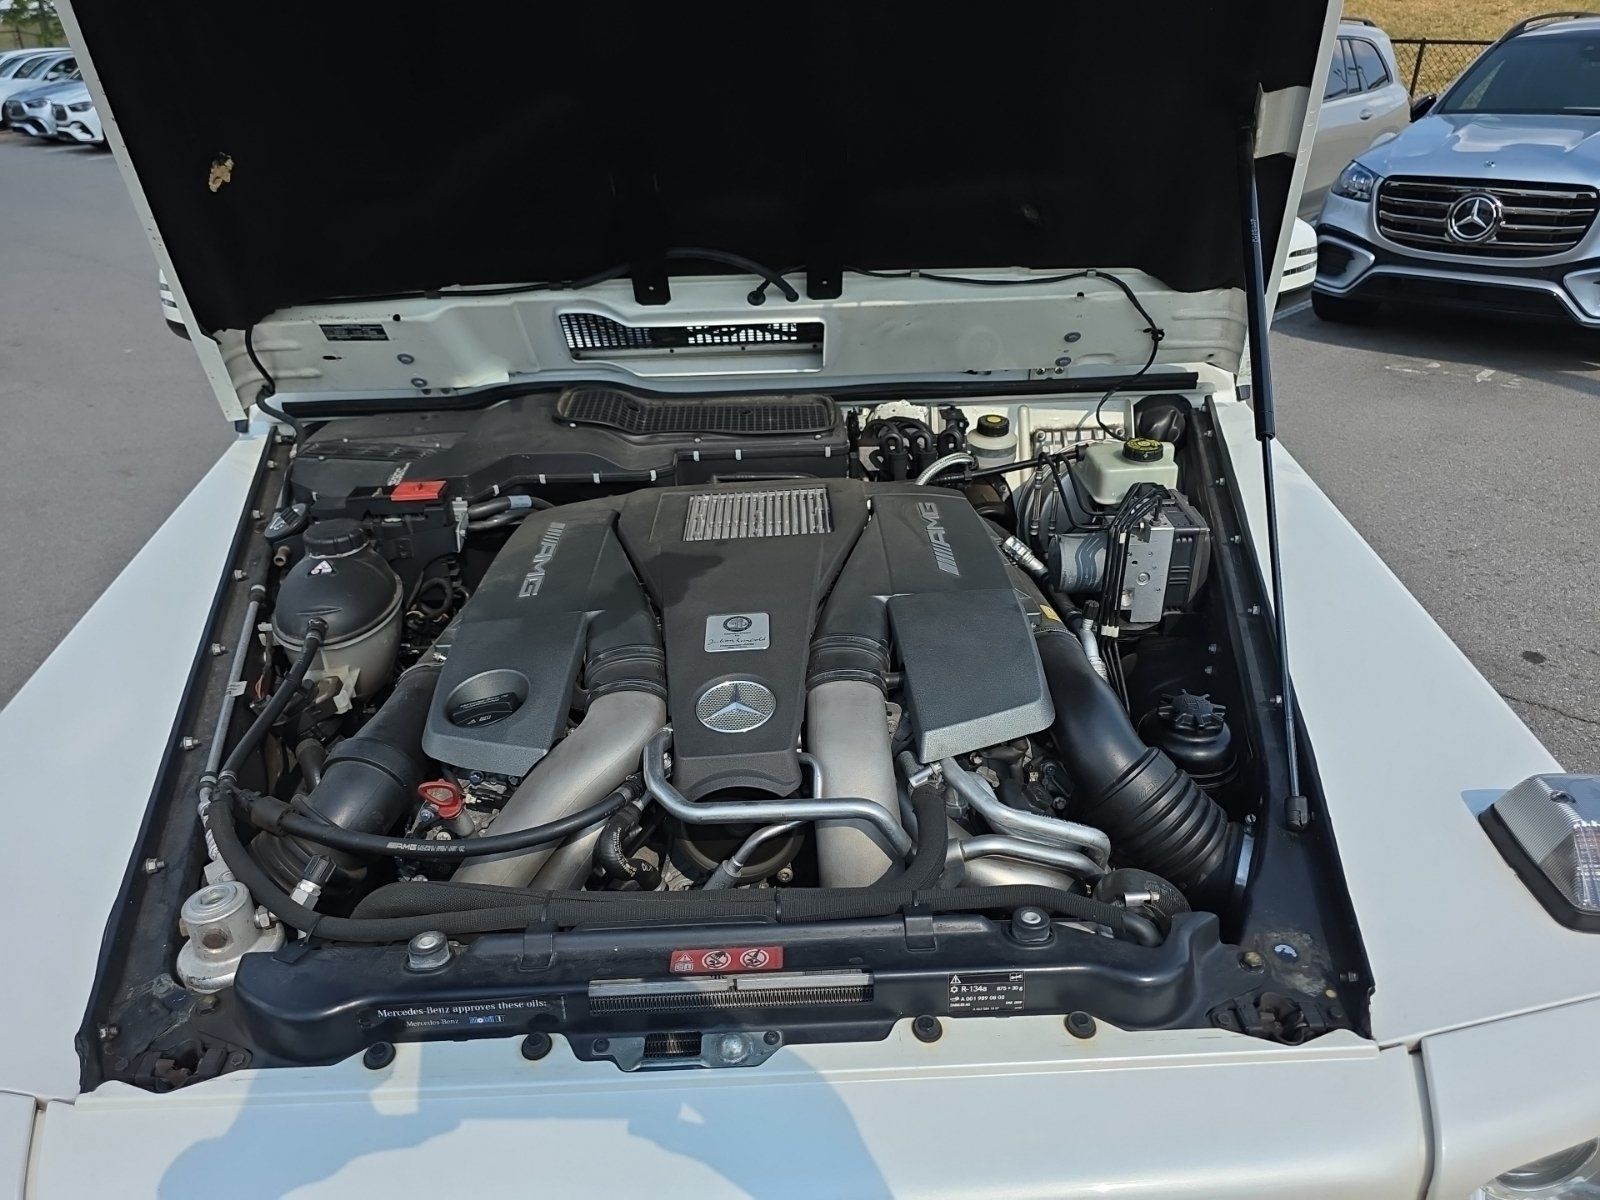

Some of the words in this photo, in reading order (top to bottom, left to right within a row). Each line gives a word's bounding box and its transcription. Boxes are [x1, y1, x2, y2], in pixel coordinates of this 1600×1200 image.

[377, 1006, 450, 1018] Mercedes-Benz
[452, 1002, 496, 1015] approves
[498, 1002, 524, 1010] these
[526, 1000, 547, 1008] oils:
[406, 1018, 459, 1027] Mercedes-Benz
